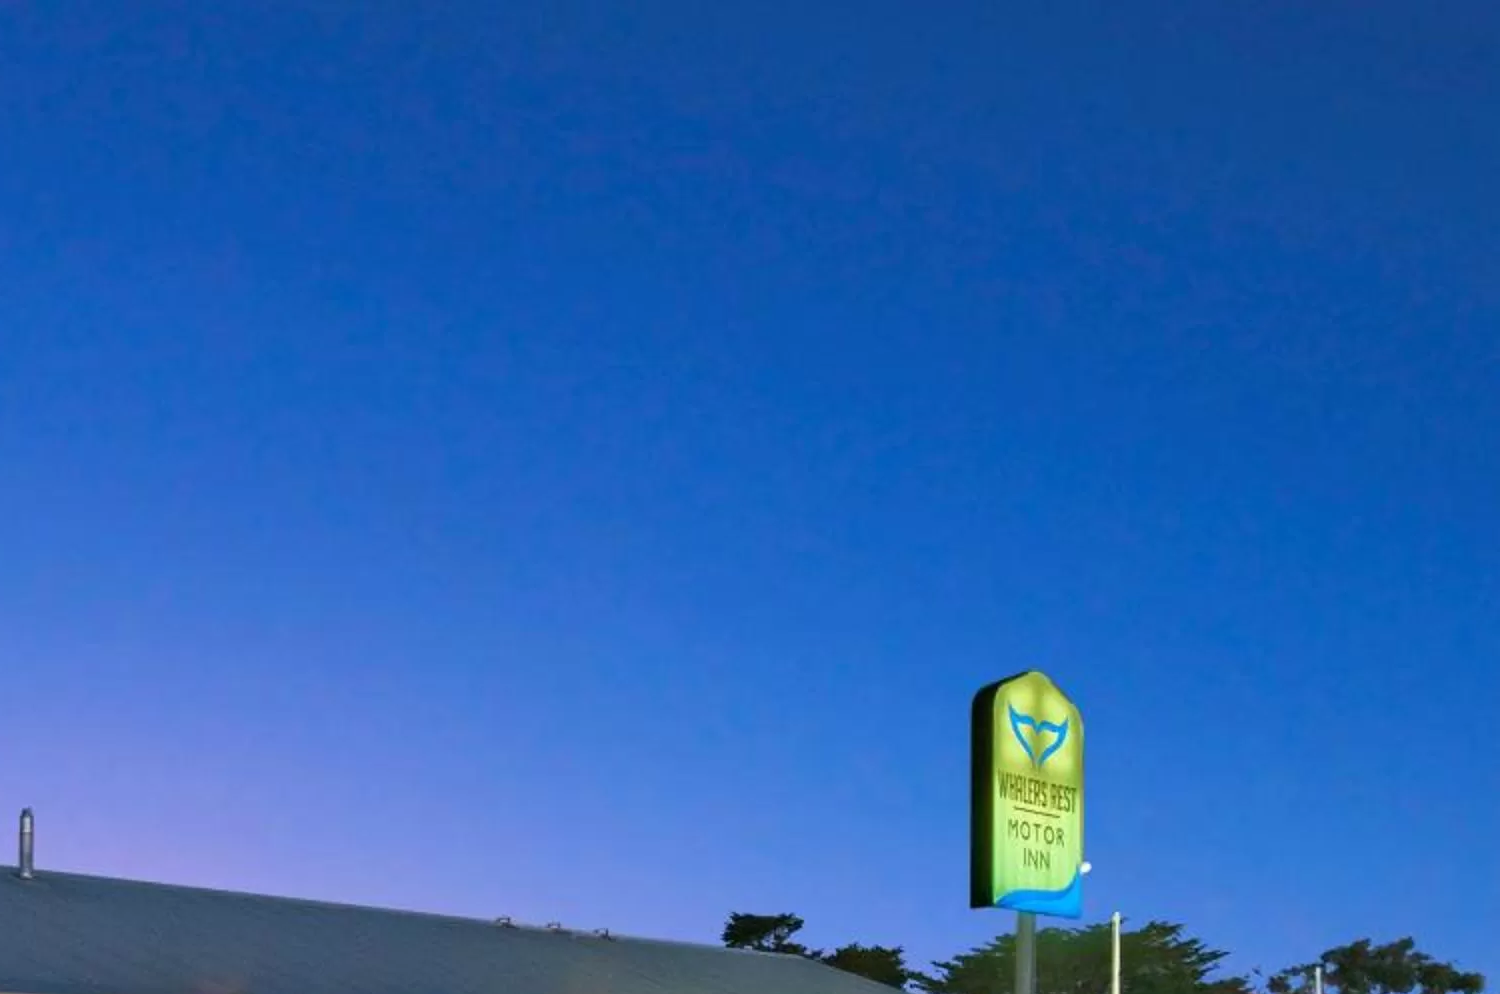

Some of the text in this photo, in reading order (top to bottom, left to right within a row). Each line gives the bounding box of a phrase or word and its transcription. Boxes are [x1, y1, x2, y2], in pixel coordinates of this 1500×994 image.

[998, 769, 1077, 814] WHALERS REST
[1008, 819, 1065, 848] MOTOR
[1023, 848, 1051, 870] INN
